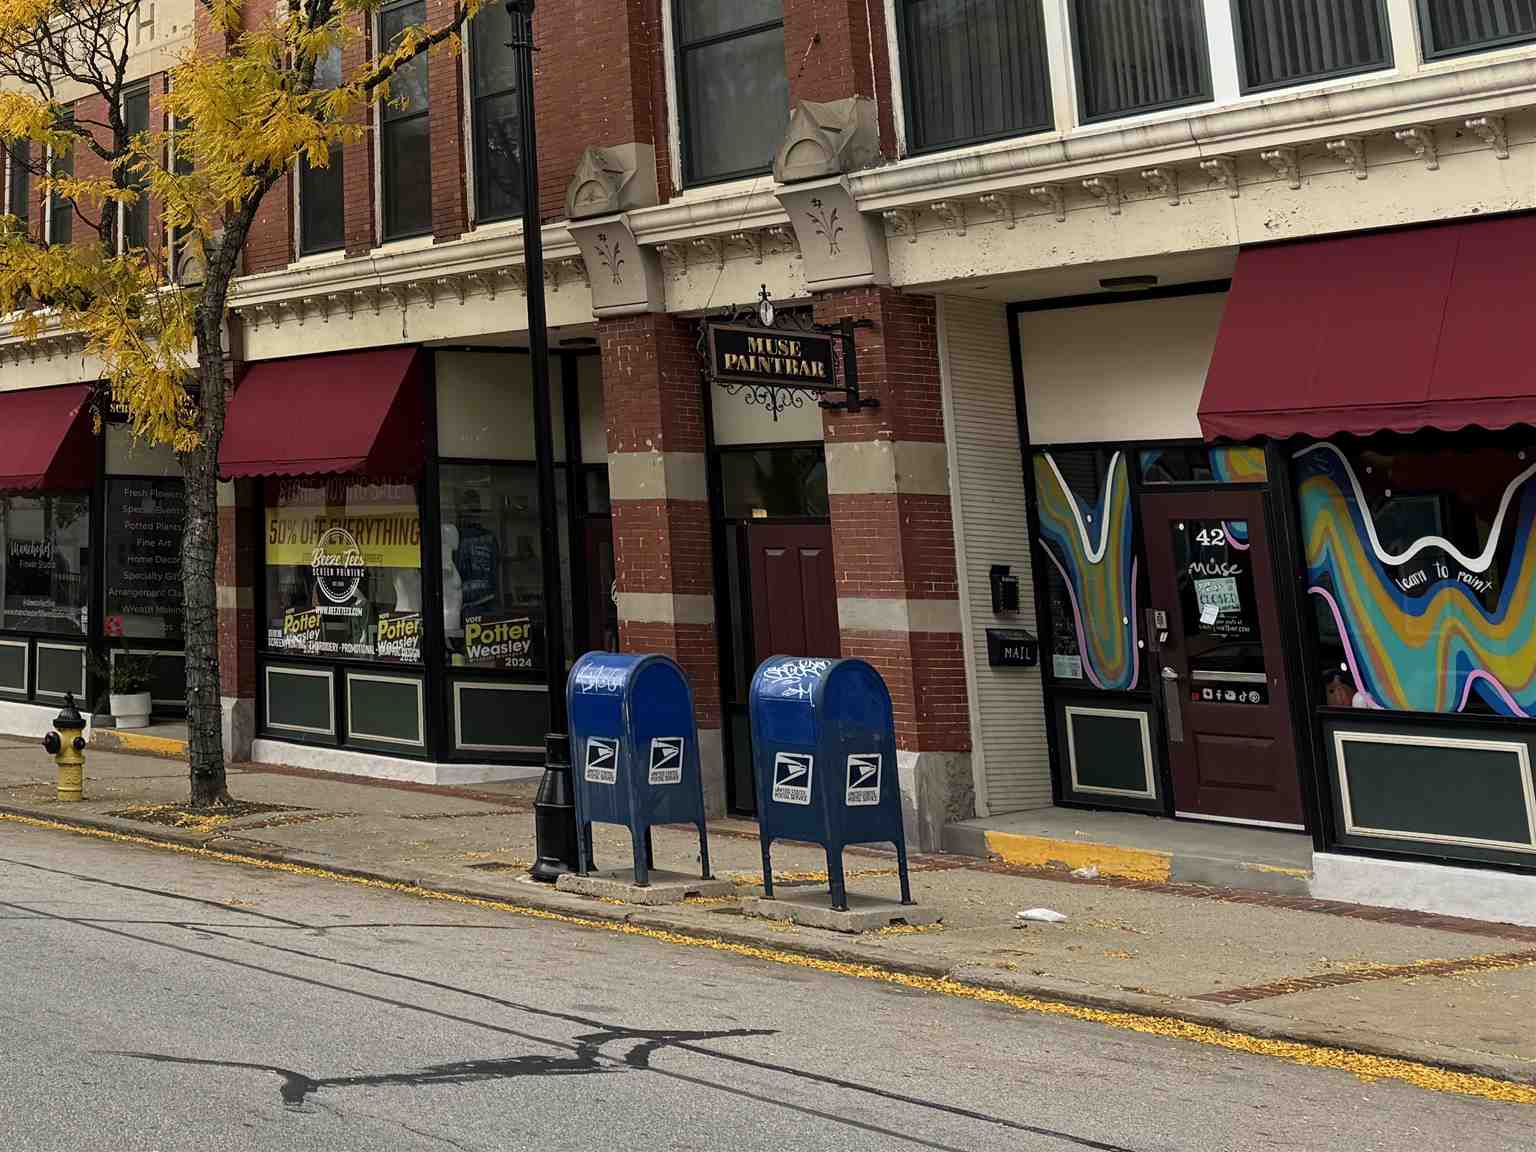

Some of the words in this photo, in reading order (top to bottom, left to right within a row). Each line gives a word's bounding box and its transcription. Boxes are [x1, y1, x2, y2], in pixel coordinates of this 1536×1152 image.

[748, 336, 802, 357] MUSE
[724, 353, 827, 378] PAINTBAR
[269, 519, 297, 545] 50%
[301, 519, 327, 545] OFF
[328, 517, 421, 546] EVERYTHING
[1195, 528, 1226, 546] 42
[136, 538, 156, 547] Fine
[157, 539, 172, 547] Art
[343, 549, 365, 568] Tees
[312, 568, 334, 576] SCREEN
[336, 568, 365, 577] PRINTING
[1395, 569, 1427, 592] learn
[1431, 561, 1449, 579] to
[1456, 571, 1493, 593] paint
[284, 611, 321, 634] Potter
[378, 618, 419, 641] Potter
[465, 623, 529, 646] Potter
[377, 635, 419, 654] Weasley
[466, 639, 530, 658] Weasley
[1004, 646, 1032, 660] MAIL
[504, 657, 532, 668] 2024
